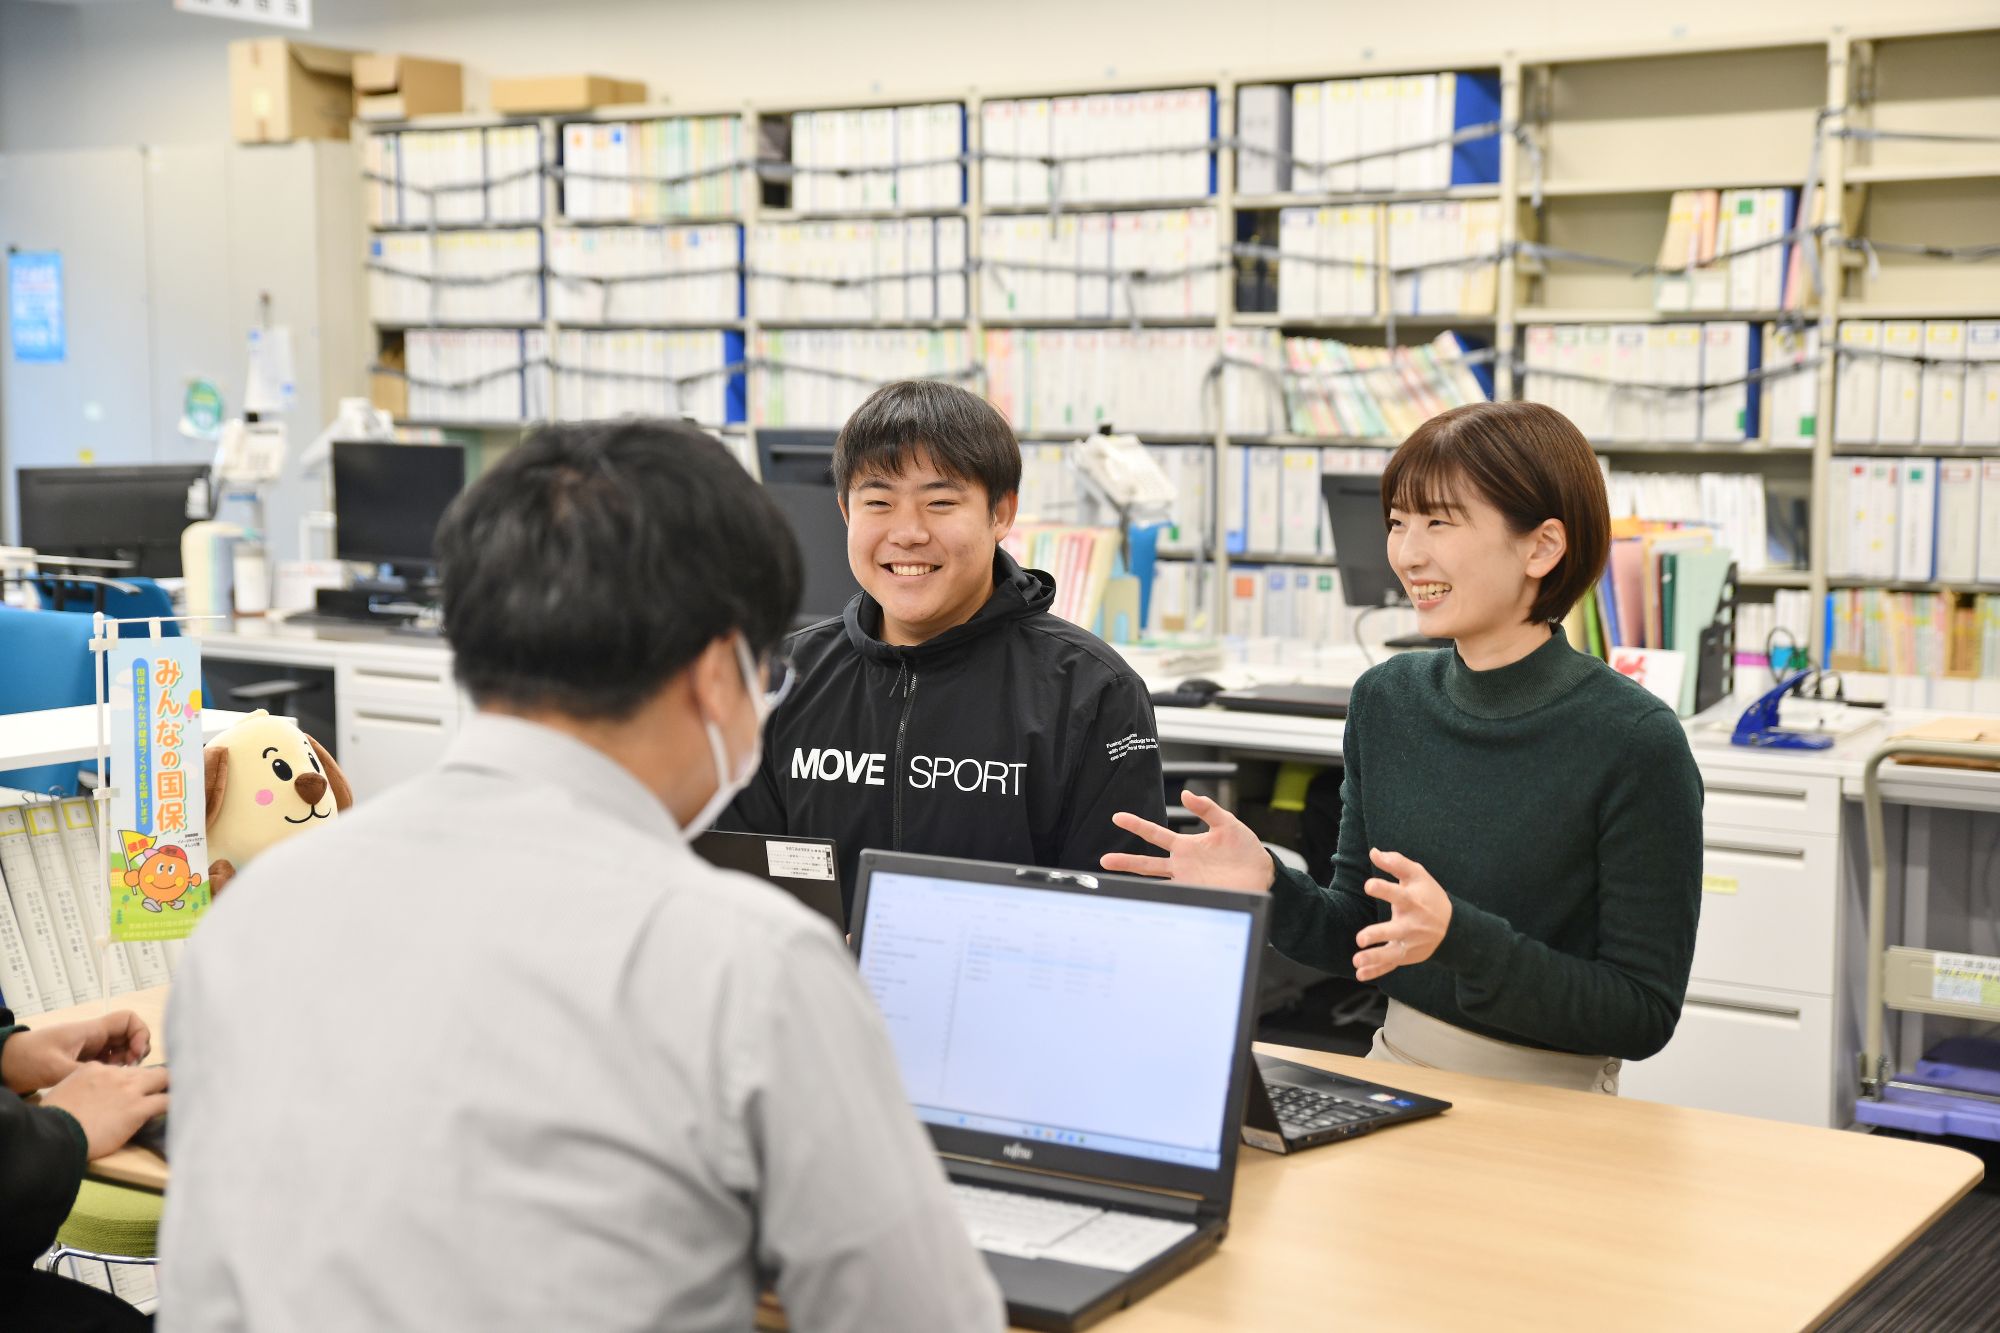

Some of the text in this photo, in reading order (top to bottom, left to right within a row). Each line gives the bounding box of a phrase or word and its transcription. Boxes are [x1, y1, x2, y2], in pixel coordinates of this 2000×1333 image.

[155, 657, 187, 833] みんなの国保
[791, 747, 1028, 796] MOVE SPORT
